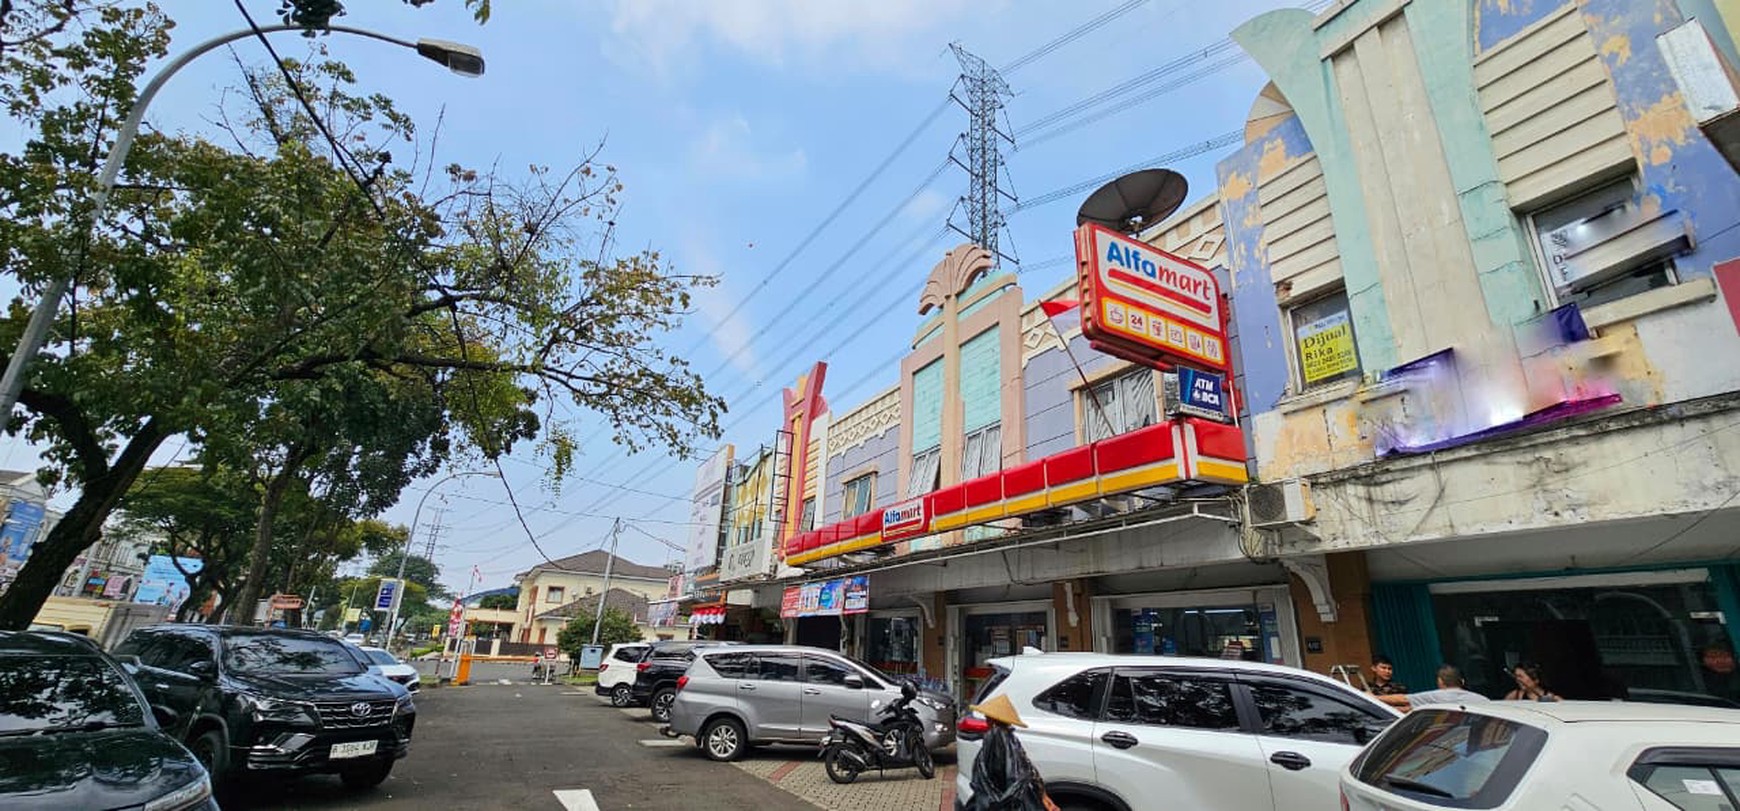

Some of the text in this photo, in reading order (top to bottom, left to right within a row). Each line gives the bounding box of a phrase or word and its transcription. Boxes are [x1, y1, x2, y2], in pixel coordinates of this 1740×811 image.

[1107, 241, 1210, 300] Alfamart
[1131, 314, 1142, 326] 24
[1304, 324, 1346, 348] Dijual
[1305, 347, 1333, 361] Rika
[1194, 378, 1214, 391] ATM
[1202, 391, 1220, 405] BCA
[885, 504, 920, 523] Alfamart
